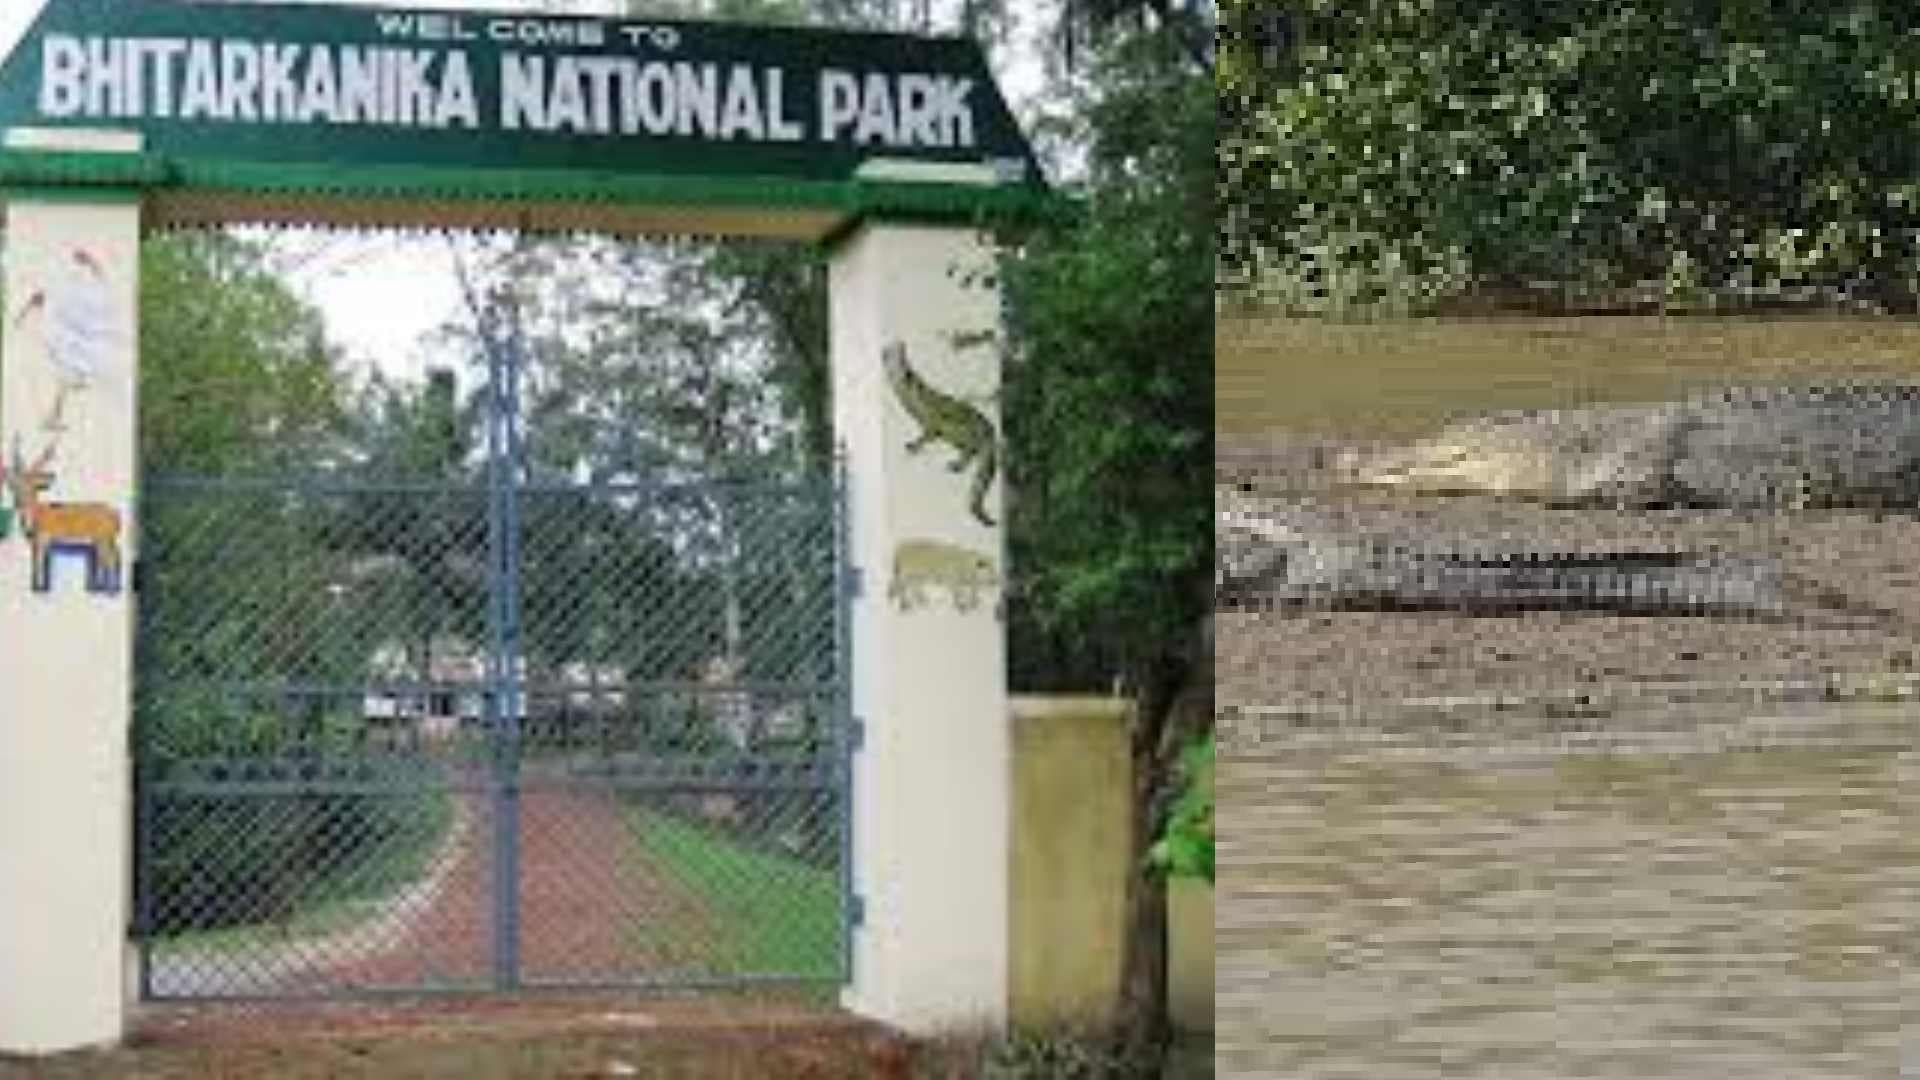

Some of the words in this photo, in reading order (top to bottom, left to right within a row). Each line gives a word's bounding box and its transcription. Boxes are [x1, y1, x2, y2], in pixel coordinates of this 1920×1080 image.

[620, 25, 681, 49] TO
[40, 35, 479, 129] BHITARKANIKA
[500, 52, 803, 142] NATIONAL
[820, 68, 975, 147] PARK
